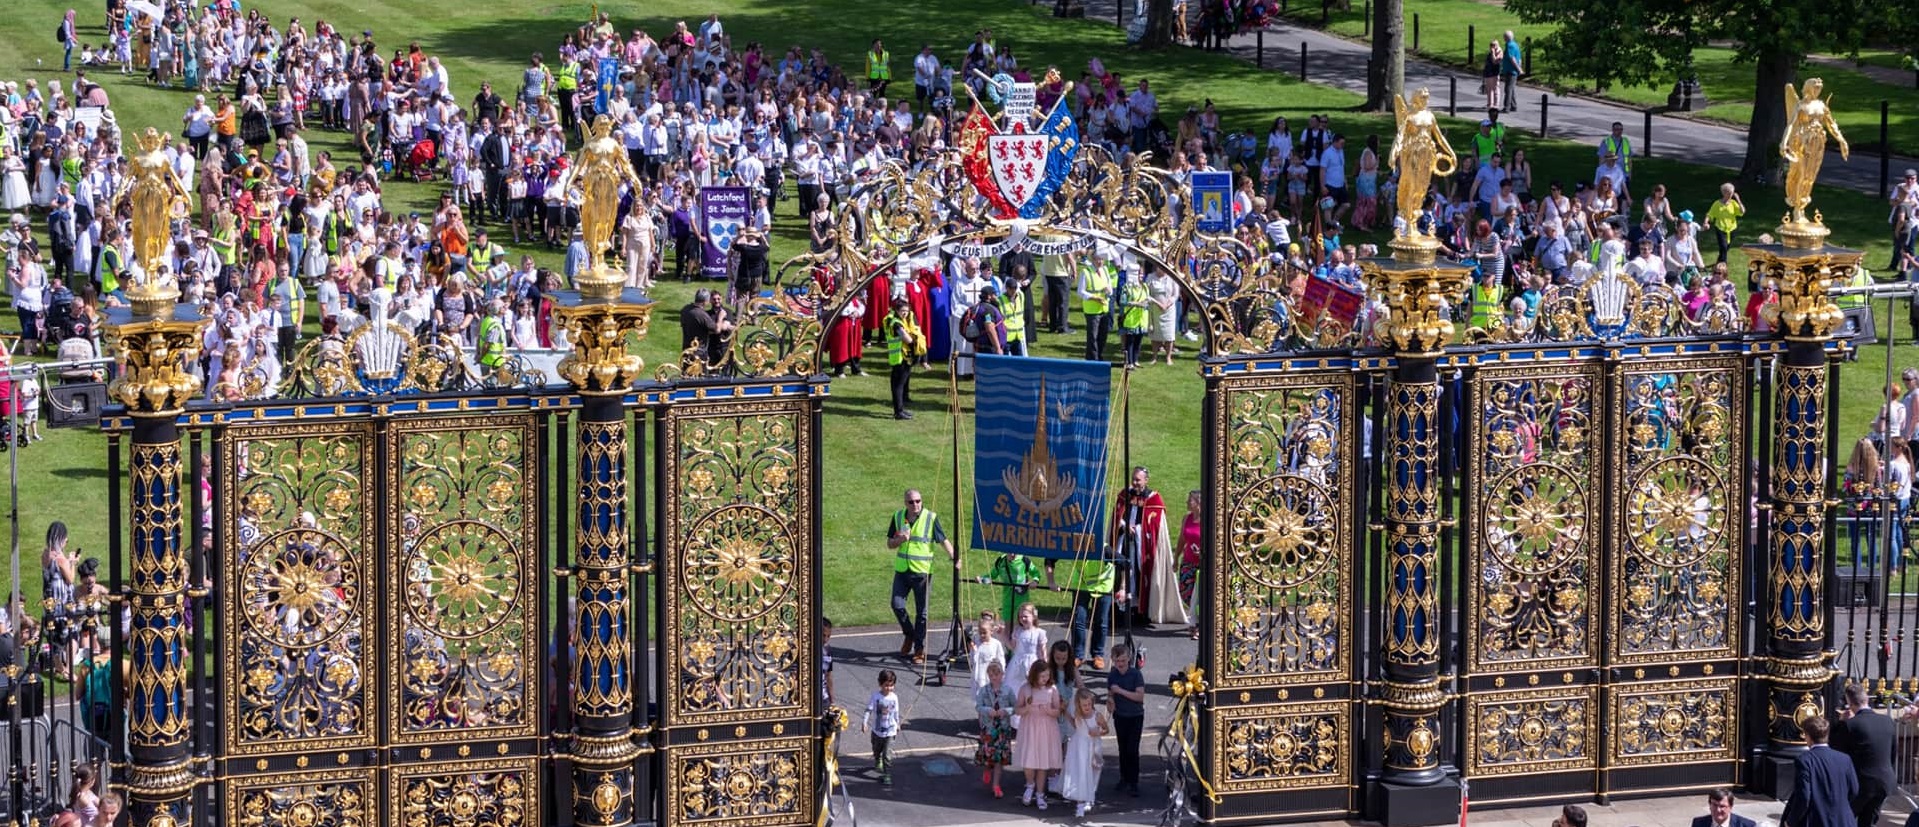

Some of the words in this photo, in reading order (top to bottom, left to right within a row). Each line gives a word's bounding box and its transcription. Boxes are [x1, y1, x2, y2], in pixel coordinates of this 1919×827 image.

[707, 193, 745, 201] Latchford
[708, 205, 718, 213] St
[721, 205, 745, 213] James
[954, 245, 981, 256] DEUS
[991, 241, 1011, 254] DAT
[1016, 501, 1085, 528] ELPHIN
[981, 519, 1096, 552] WARRINGTON
